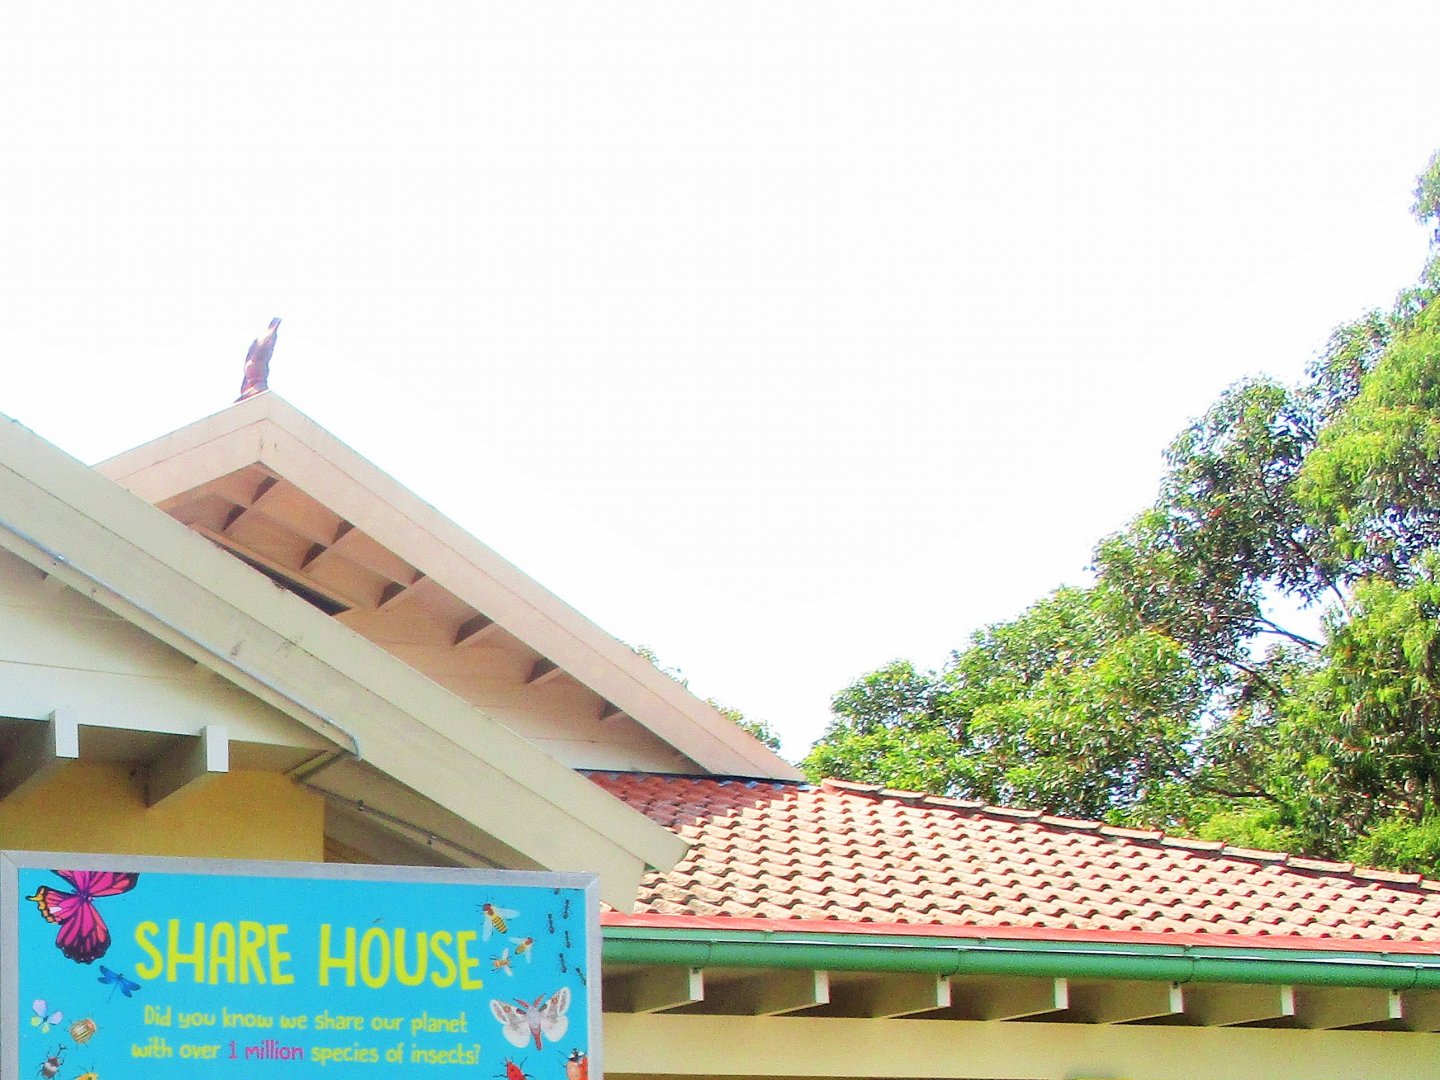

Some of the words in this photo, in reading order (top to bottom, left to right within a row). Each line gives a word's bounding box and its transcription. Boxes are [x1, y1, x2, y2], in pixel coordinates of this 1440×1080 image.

[133, 918, 295, 986] SHARE
[318, 923, 483, 991] HOUSE
[144, 1005, 172, 1027] Did
[177, 1011, 216, 1029] you
[222, 1007, 274, 1029] know
[279, 1014, 308, 1029] we
[314, 1010, 364, 1032] share
[370, 1015, 404, 1031] our
[411, 1012, 468, 1036] planet
[131, 1037, 173, 1058] with
[179, 1043, 221, 1059] over
[228, 1040, 237, 1060] 1
[245, 1040, 305, 1061] million
[311, 1043, 379, 1066] species
[385, 1043, 405, 1063] of
[411, 1044, 481, 1065] insects?
